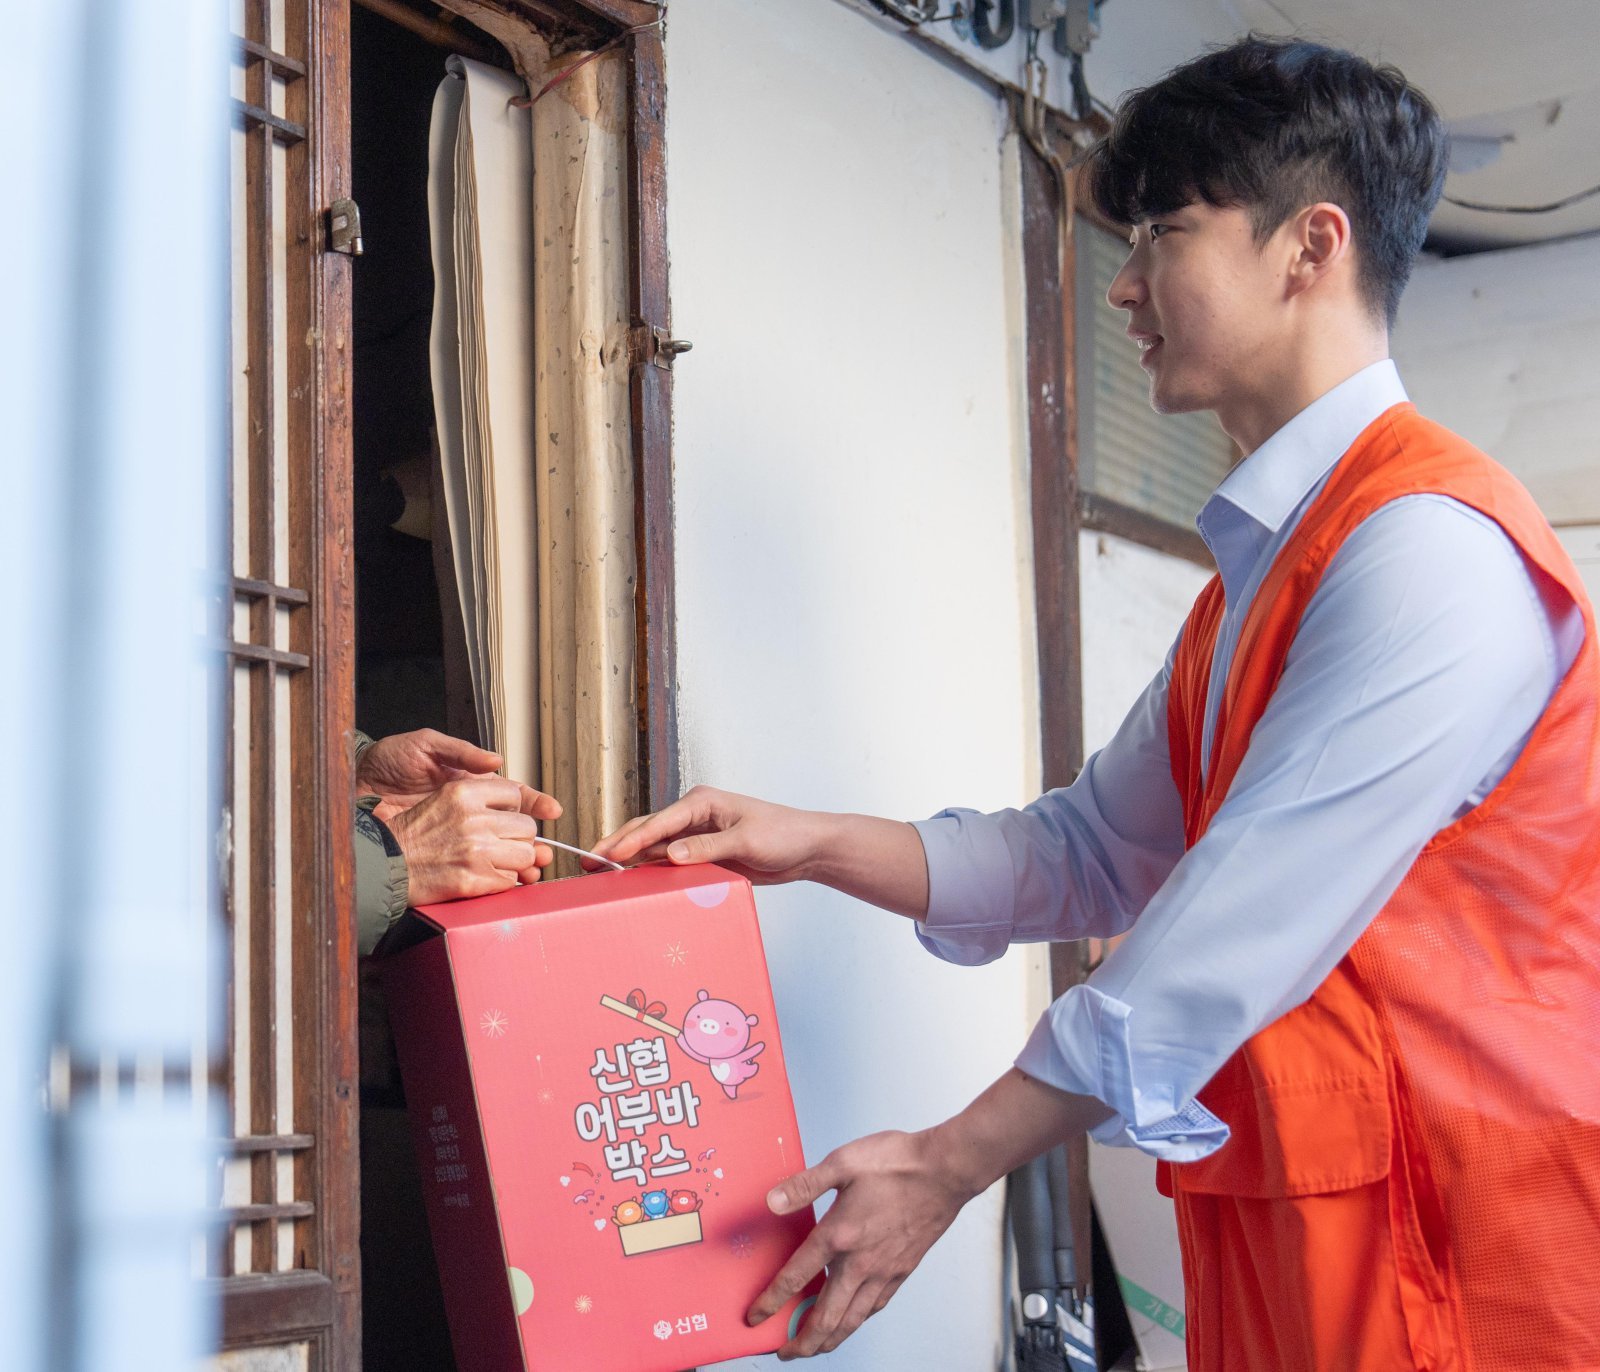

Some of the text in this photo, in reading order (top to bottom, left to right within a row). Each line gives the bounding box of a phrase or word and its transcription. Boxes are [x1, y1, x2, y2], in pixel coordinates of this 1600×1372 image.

[590, 1036, 670, 1093] 신협
[574, 1081, 701, 1142] 어부바
[602, 1134, 691, 1186] 박스
[675, 1313, 708, 1335] 신협
